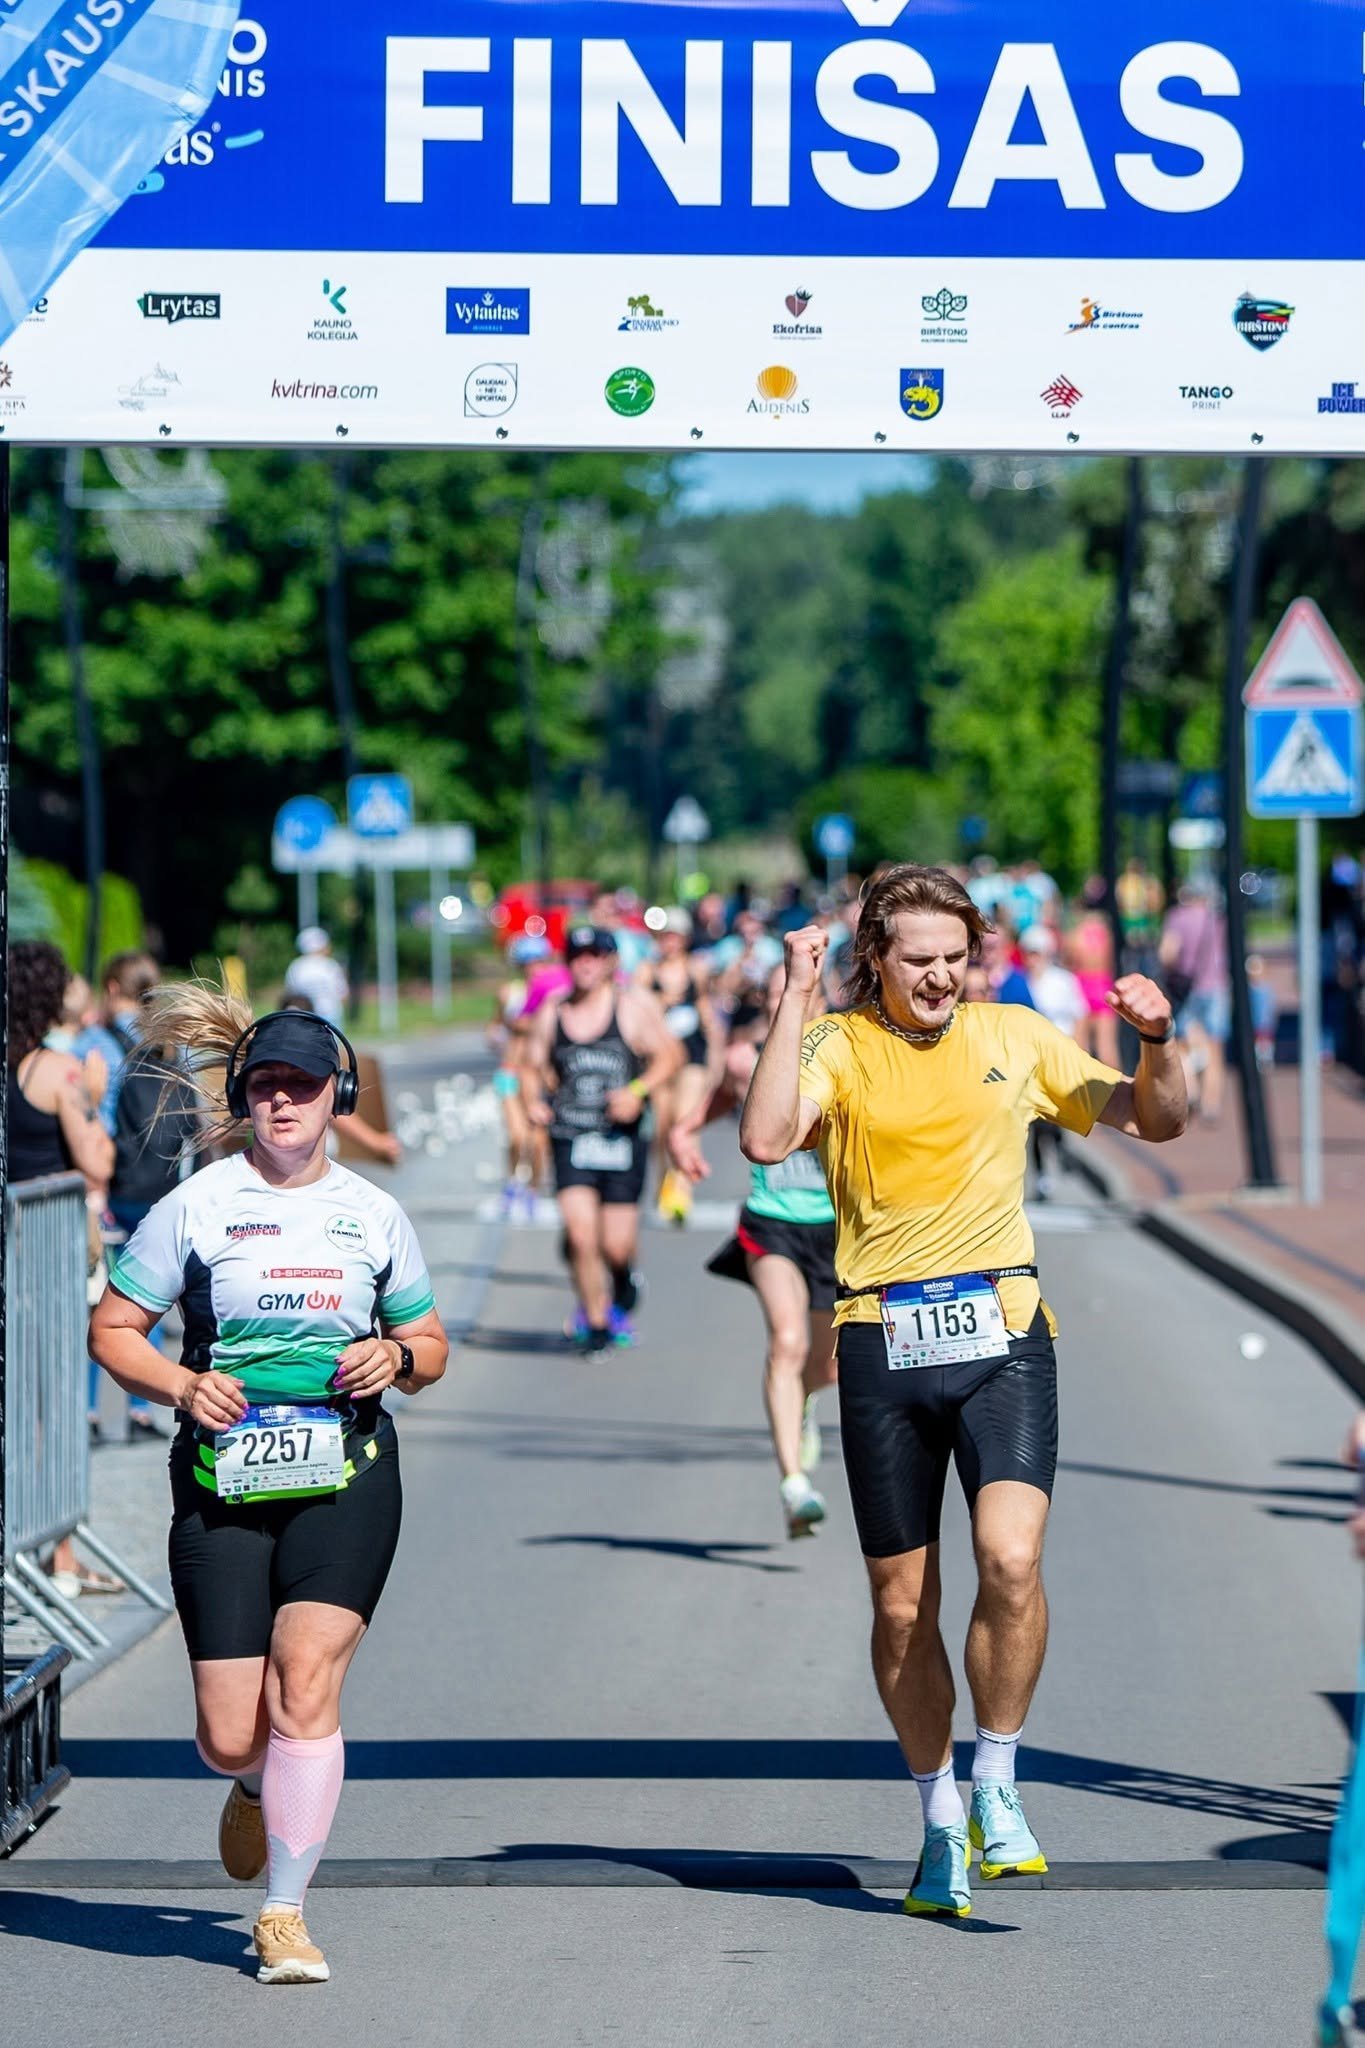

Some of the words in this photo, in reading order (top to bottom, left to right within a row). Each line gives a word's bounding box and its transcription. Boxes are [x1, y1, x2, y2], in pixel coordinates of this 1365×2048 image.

[385, 0, 1245, 213] FINIŠAS
[147, 295, 217, 321] Lrytas
[454, 302, 520, 324] Vytautas
[313, 319, 352, 329] KAUNO
[772, 324, 822, 334] Ekofrisa
[920, 326, 968, 336] BIRŠTONO
[307, 331, 358, 341] KOLEGIJA
[271, 378, 379, 400] kvitrina.com
[1178, 386, 1234, 399] TANGO
[1331, 382, 1355, 398] ICE
[1191, 401, 1221, 410] PRINT
[272, 1268, 342, 1279] S-SPORTAS
[911, 1302, 977, 1341] 1153
[241, 1427, 313, 1467] 2257
